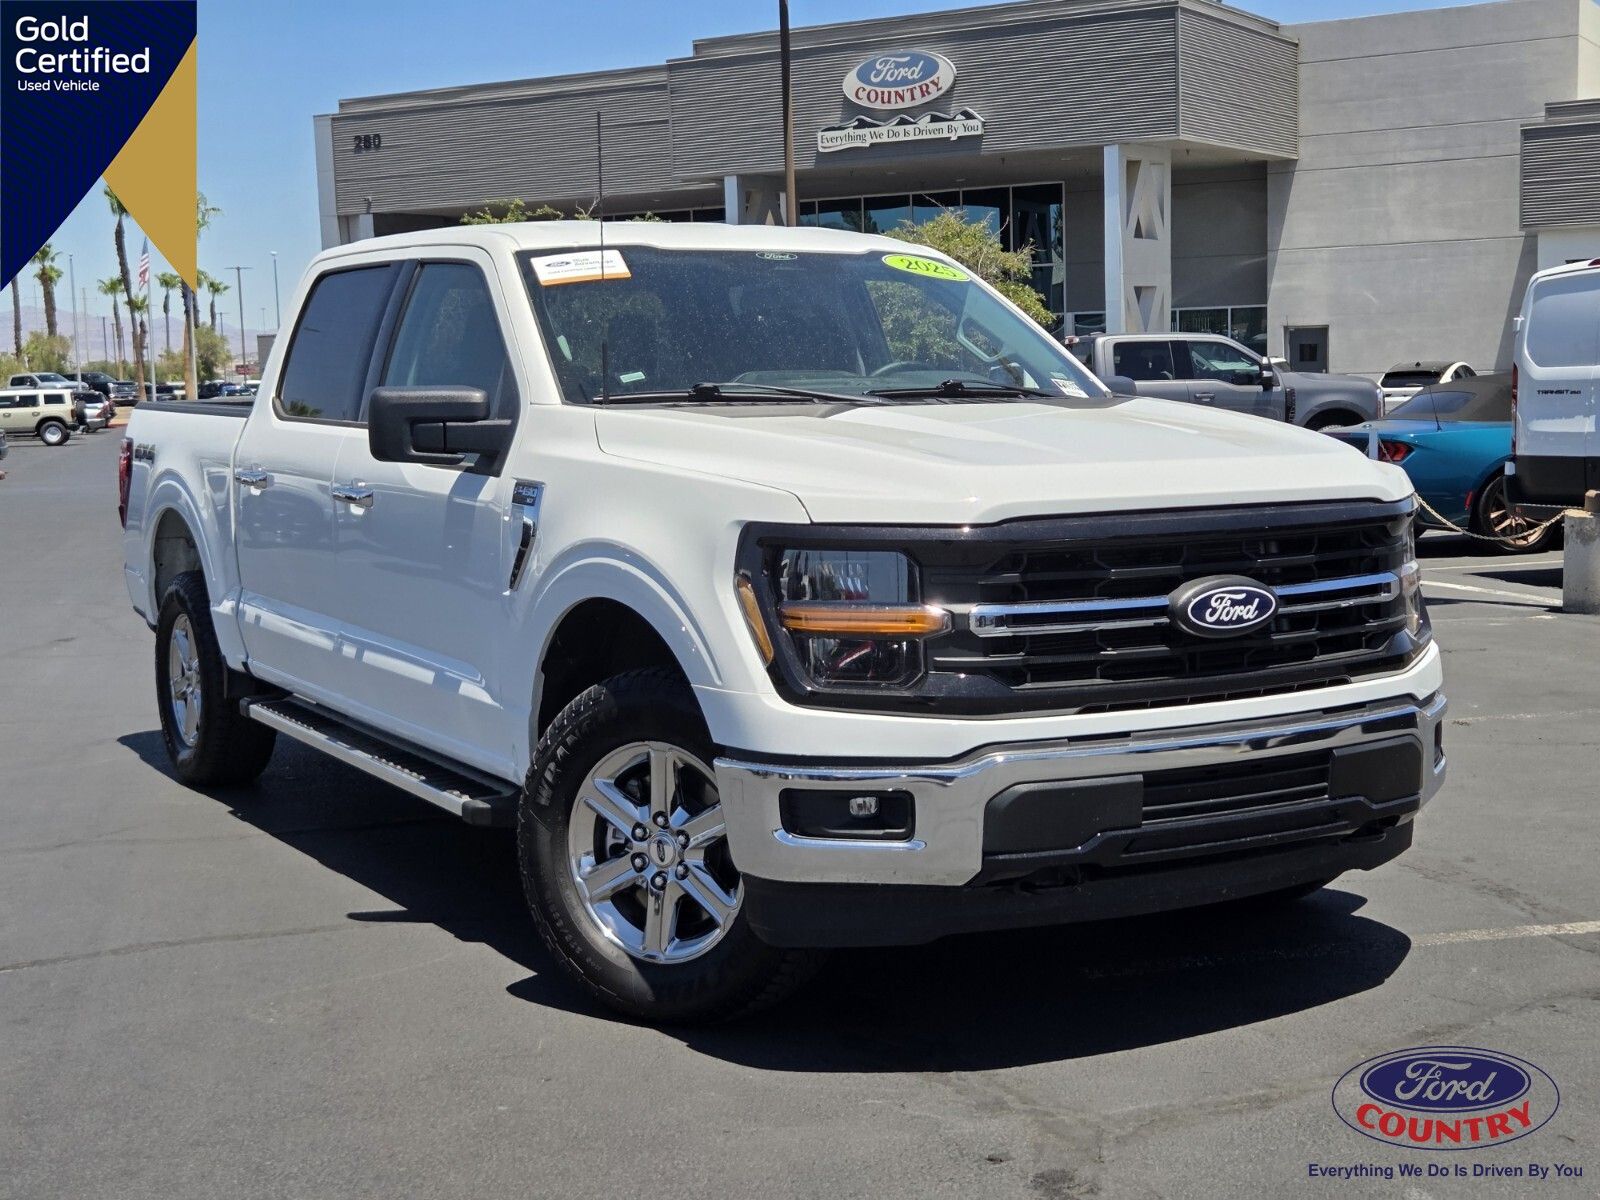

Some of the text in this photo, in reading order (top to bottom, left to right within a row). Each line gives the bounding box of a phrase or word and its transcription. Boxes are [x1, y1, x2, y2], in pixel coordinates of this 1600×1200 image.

[870, 56, 923, 83] Ford
[854, 76, 943, 105] COUNTRY
[820, 122, 979, 146] Everything We Do Is Driven By You
[900, 258, 957, 278] 2025
[1205, 592, 1260, 623] Ford
